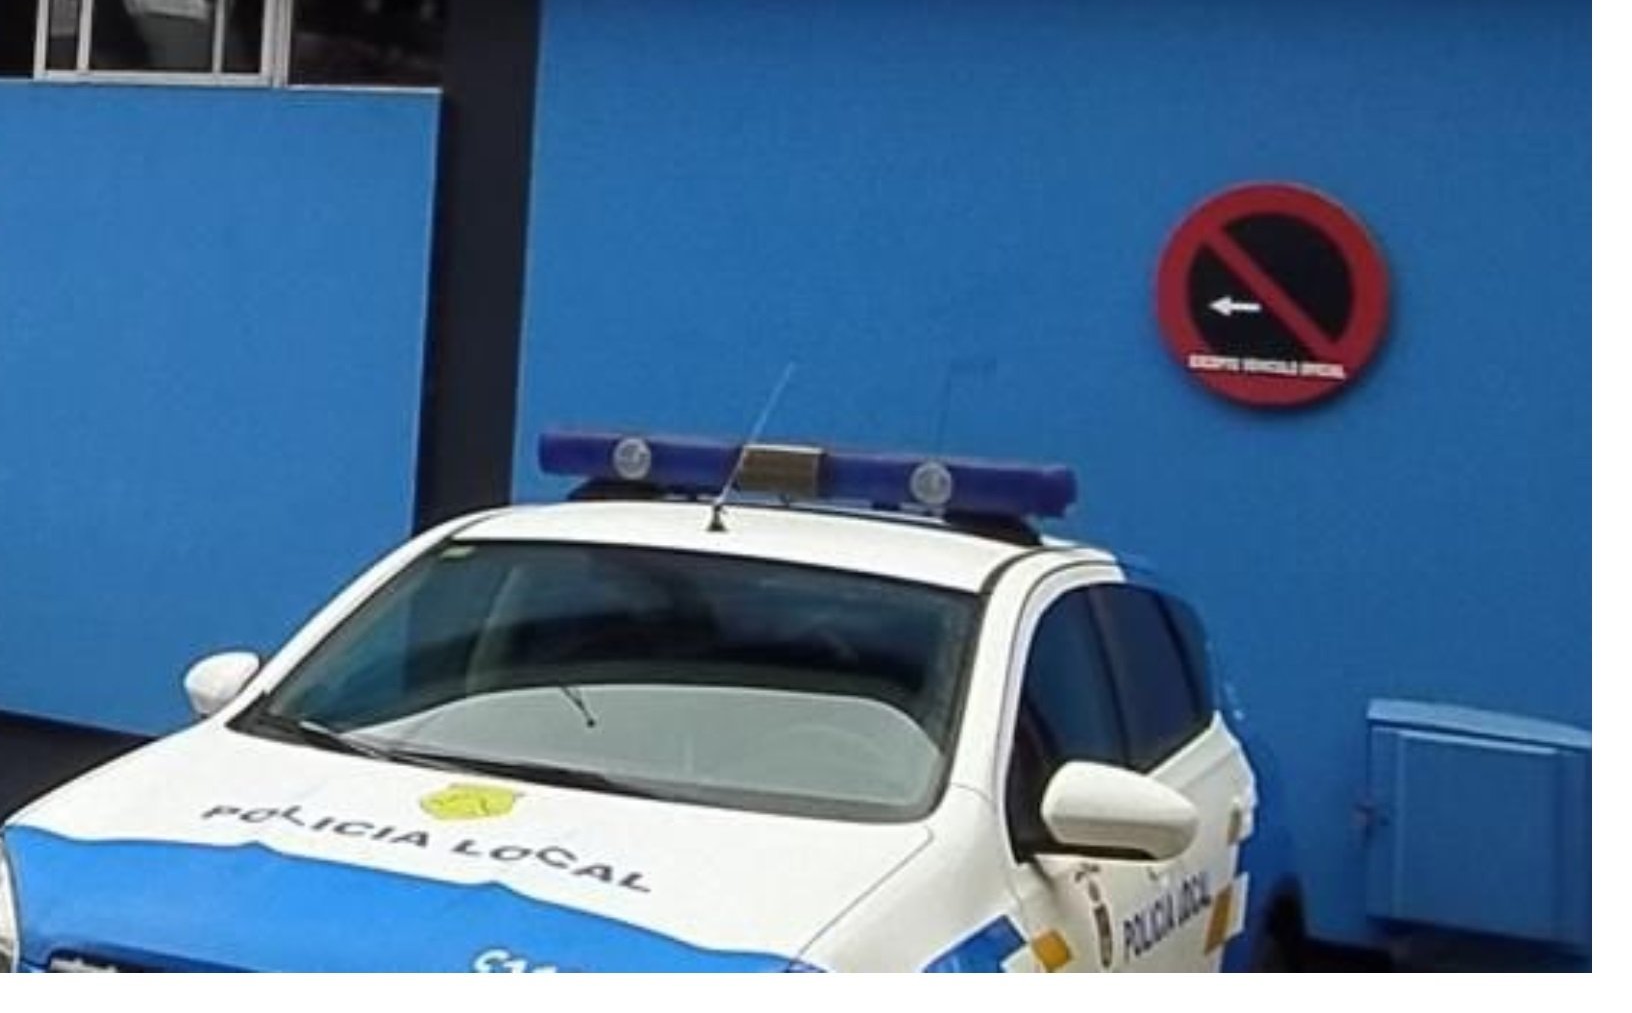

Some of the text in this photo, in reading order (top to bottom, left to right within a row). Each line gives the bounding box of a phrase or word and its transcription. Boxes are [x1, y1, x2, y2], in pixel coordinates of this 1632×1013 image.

[201, 803, 651, 893] POLICIA LOCAL
[1123, 891, 1175, 964] POLICIA
